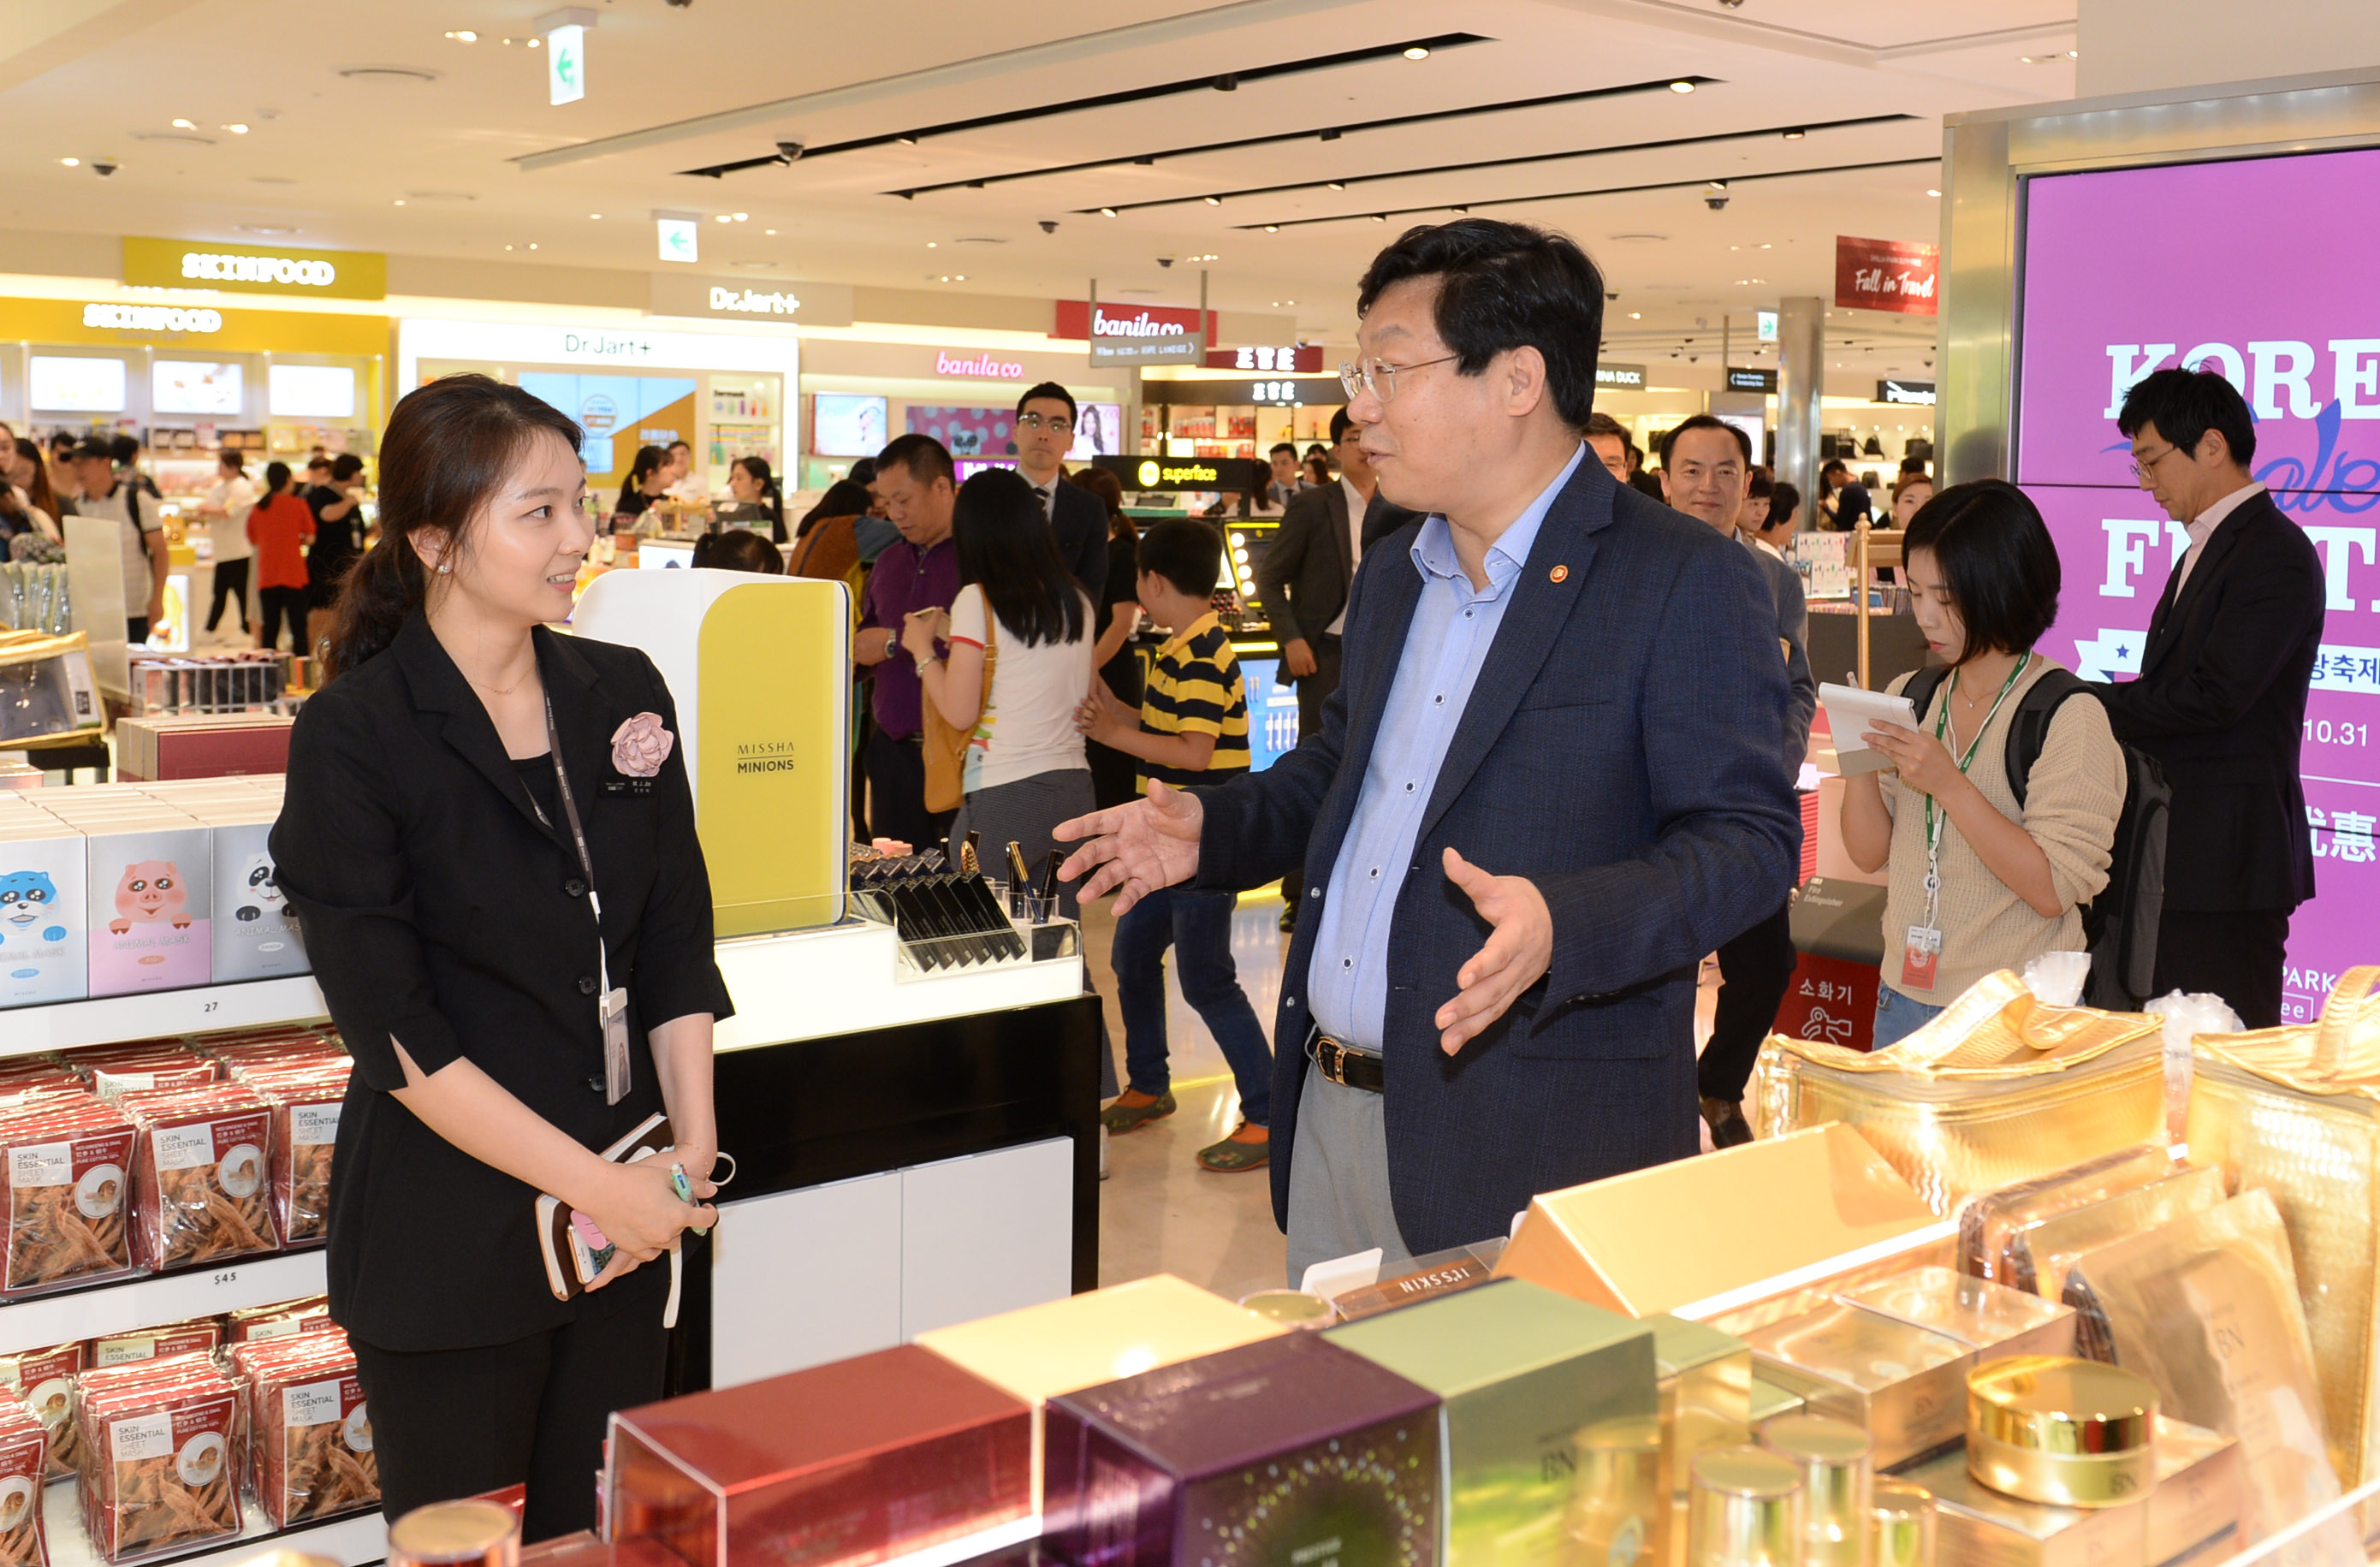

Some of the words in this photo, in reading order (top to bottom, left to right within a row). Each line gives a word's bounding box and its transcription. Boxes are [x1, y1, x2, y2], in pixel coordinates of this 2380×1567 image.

[181, 252, 335, 286] SKINFOOD
[1855, 269, 1881, 292] Fall
[1883, 276, 1897, 293] in
[1897, 271, 1935, 298] Travel
[82, 302, 223, 333] SKINFOOD
[1094, 309, 1159, 336] banila
[936, 351, 999, 377] banila
[1617, 371, 1641, 384] DUCK
[1162, 464, 1217, 484] superface
[738, 741, 794, 754] MISSHA
[738, 760, 794, 774] MINIONS
[279, 923, 301, 933] MAS
[1799, 978, 1853, 1006] 소화기
[205, 1001, 218, 1012] 27
[160, 1134, 181, 1144] SKIN
[162, 1138, 206, 1151] ESSENTIAL
[17, 1152, 39, 1162] SKIN
[105, 1352, 148, 1361] ESSENTIAL
[291, 1392, 310, 1401] SKIN
[291, 1396, 334, 1409] ESSENTIAL
[119, 1426, 139, 1435] SKIN
[120, 1429, 165, 1442] ESSENTIAL
